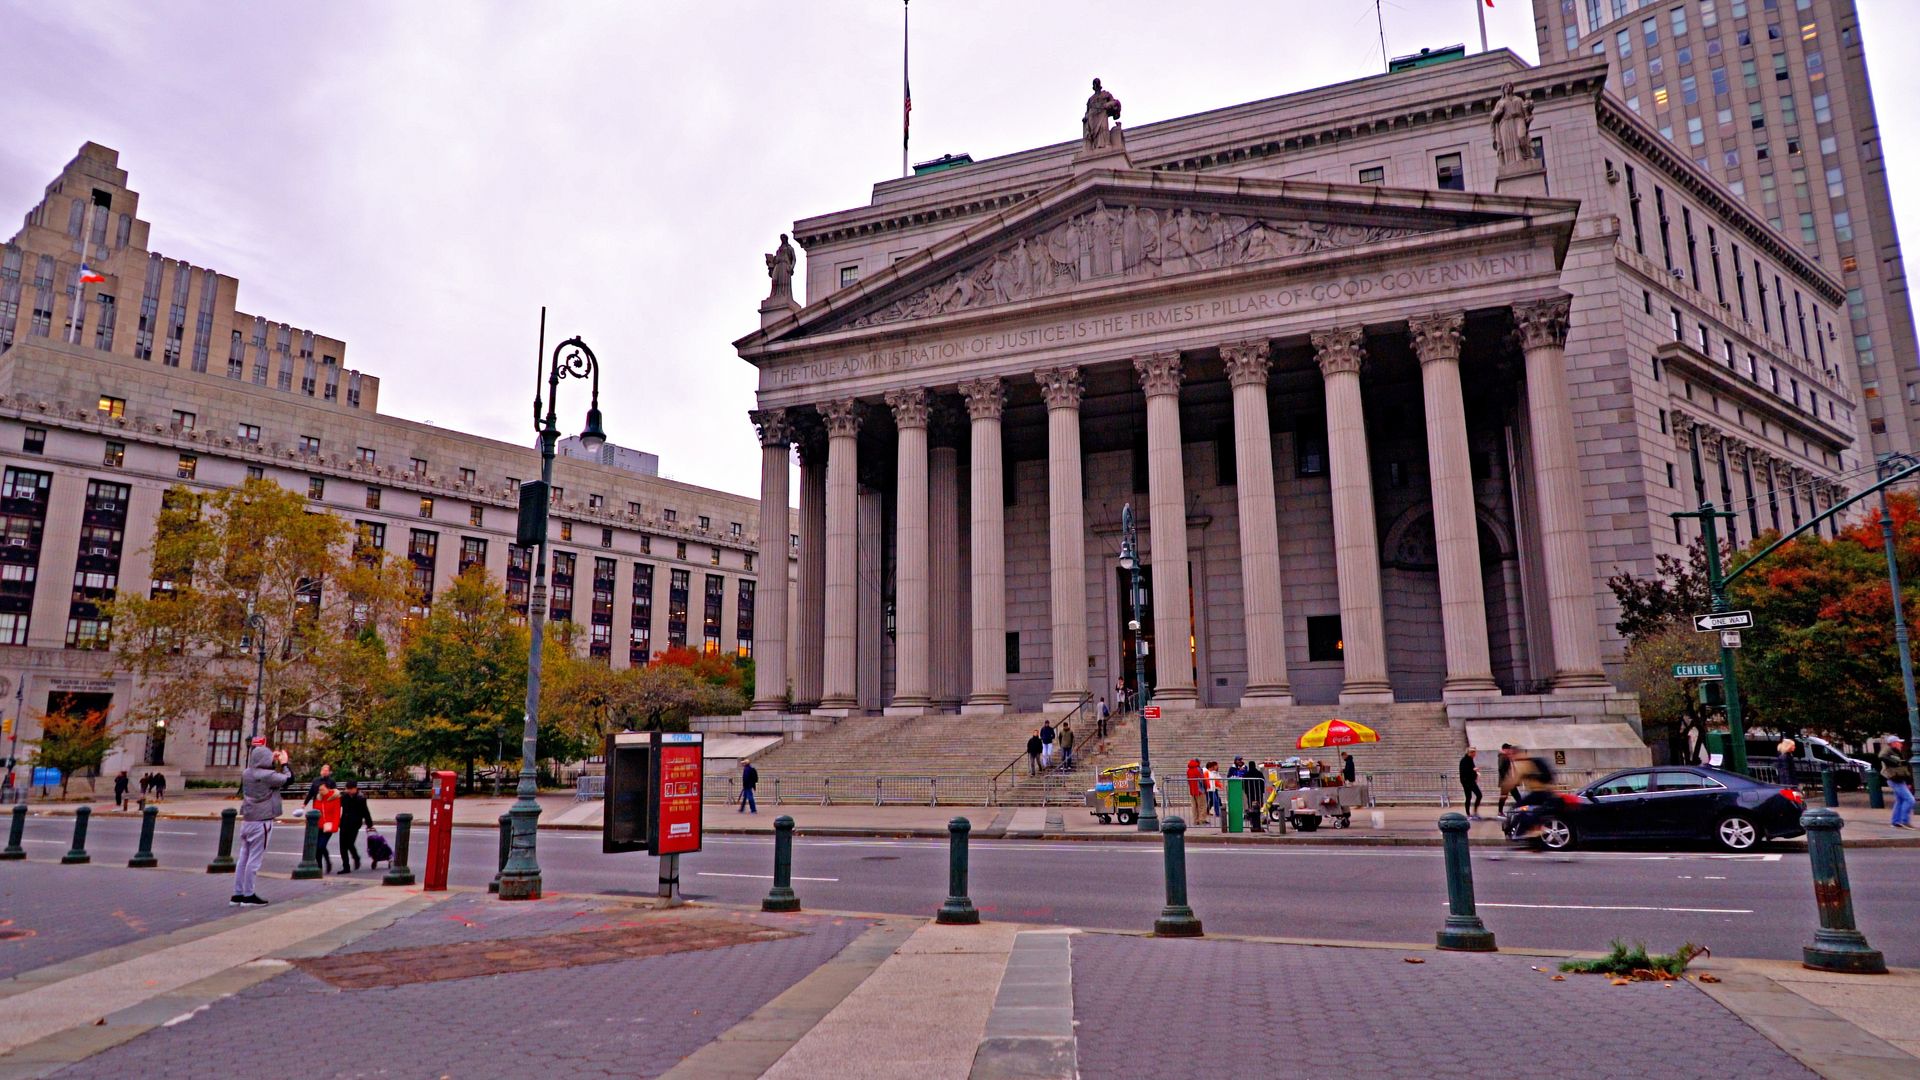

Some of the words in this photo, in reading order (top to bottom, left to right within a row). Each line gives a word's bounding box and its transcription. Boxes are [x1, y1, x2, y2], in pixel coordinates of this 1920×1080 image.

[772, 366, 797, 384] THE
[802, 361, 836, 379] TRUE
[841, 340, 965, 374] ADMINISTRATION
[971, 336, 992, 353] OF
[998, 326, 1064, 350] JUSTICE
[1072, 323, 1086, 338] IS
[1093, 316, 1122, 335] THE
[1131, 304, 1203, 329] FIRMEST
[1212, 294, 1271, 317] PILLAR
[1277, 289, 1302, 307] OF
[1311, 279, 1372, 301] GOOD
[1381, 254, 1532, 291] GOVERNMENT
[1676, 665, 1709, 675] CENTRE
